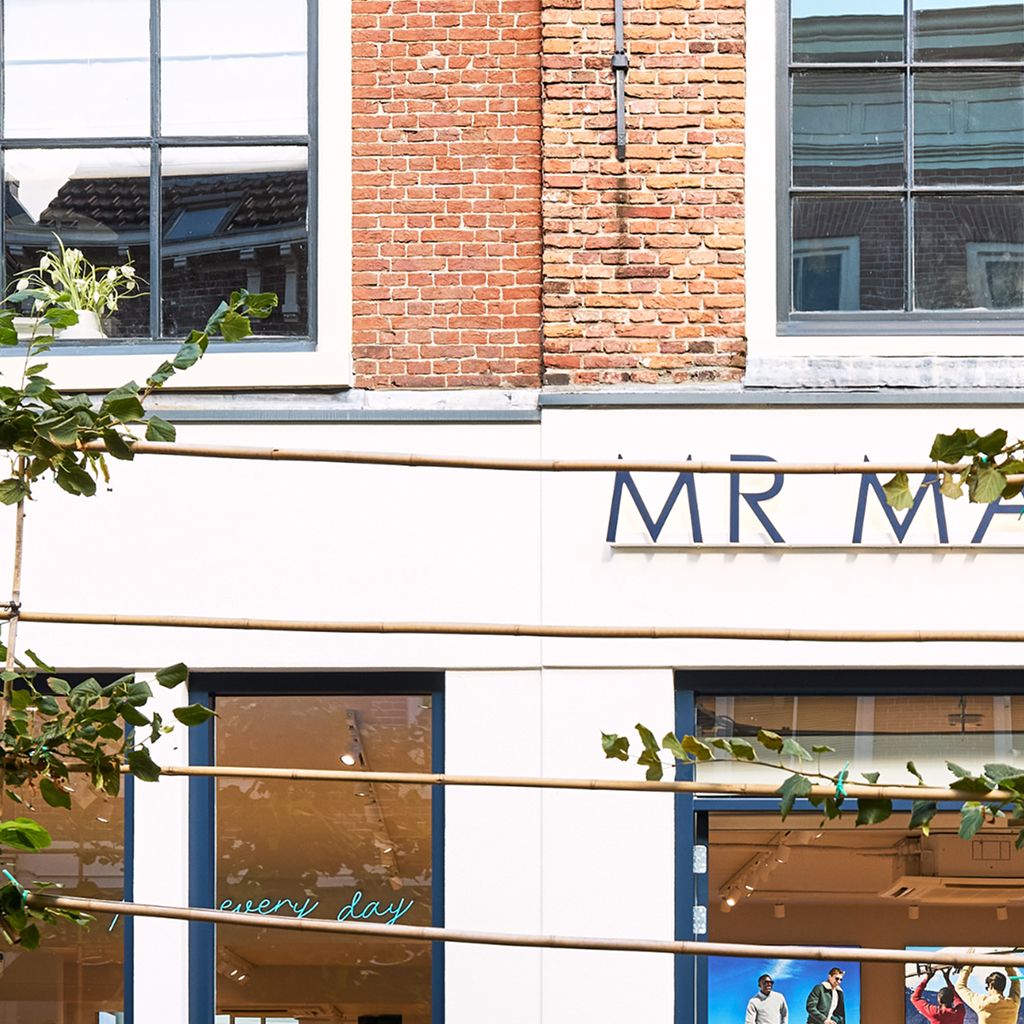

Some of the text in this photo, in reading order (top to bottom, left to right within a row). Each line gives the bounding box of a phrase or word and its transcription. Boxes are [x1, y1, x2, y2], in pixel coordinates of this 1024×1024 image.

[606, 454, 786, 543] MR
[219, 890, 415, 926] every day
